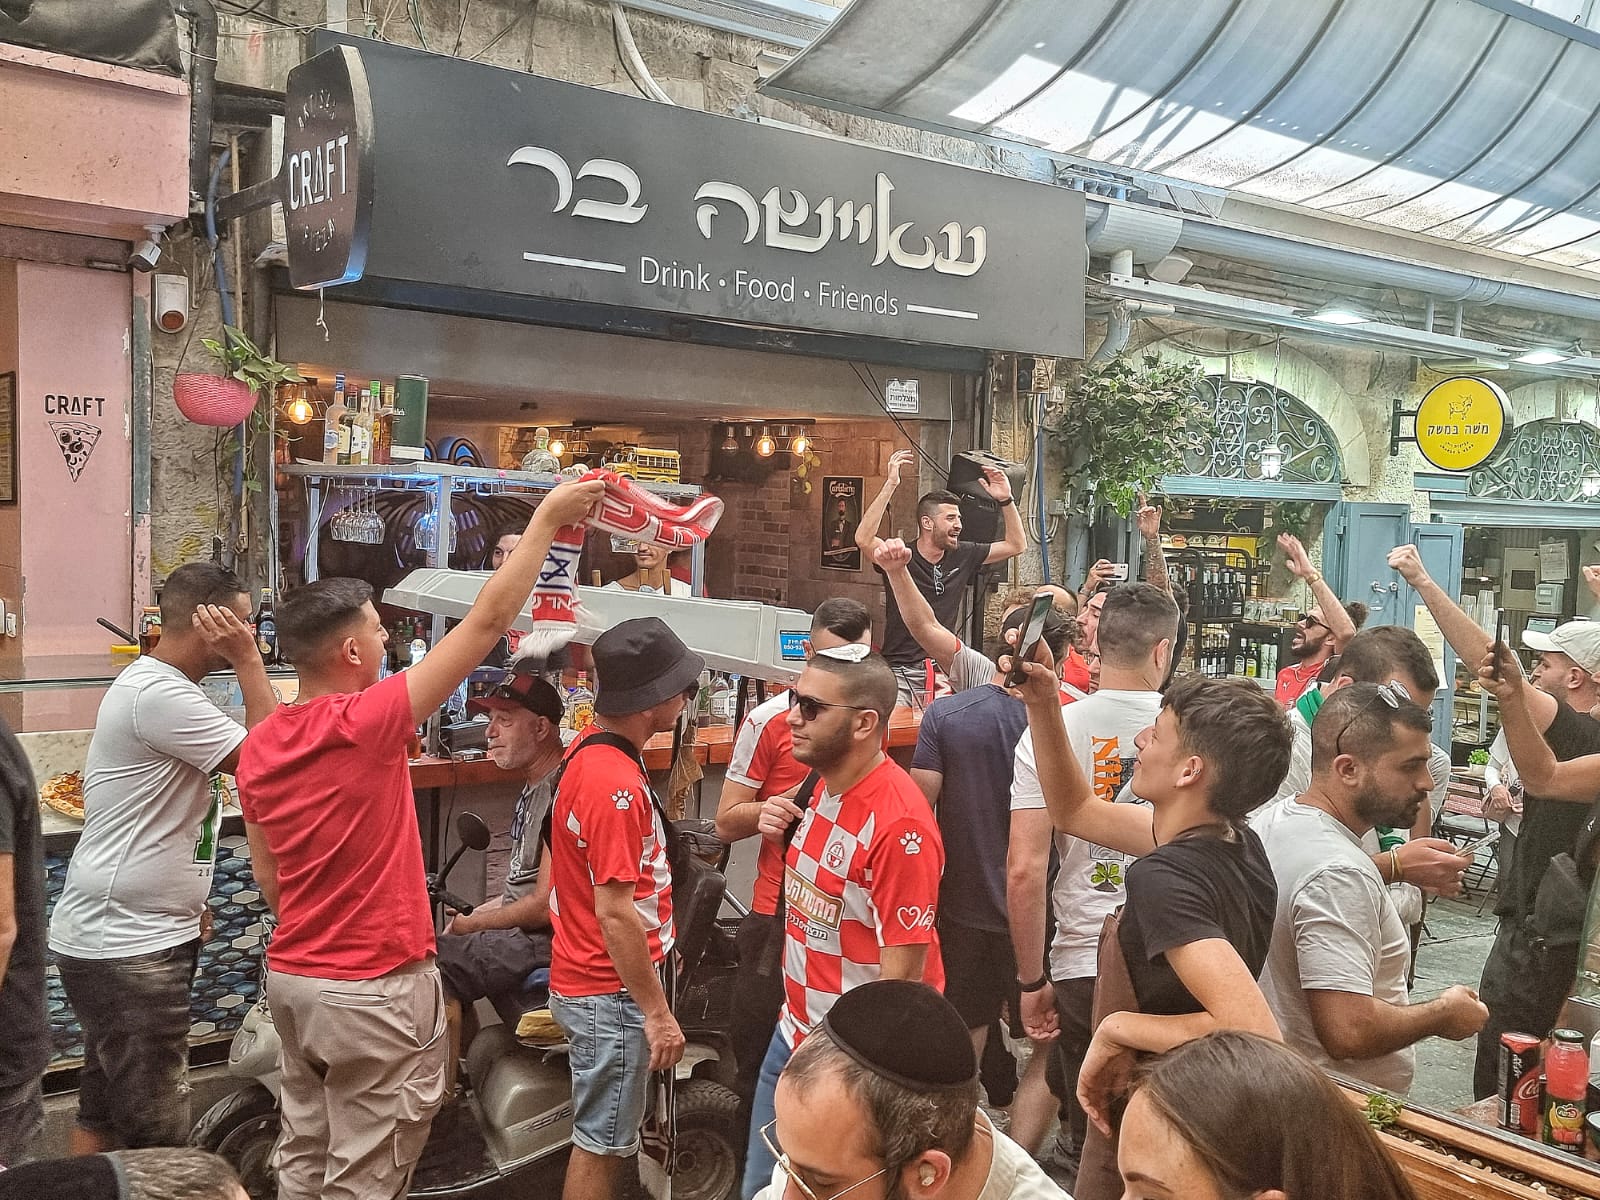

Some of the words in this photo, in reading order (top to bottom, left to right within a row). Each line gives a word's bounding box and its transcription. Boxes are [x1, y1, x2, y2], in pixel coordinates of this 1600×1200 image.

[289, 134, 349, 211] CRAFT
[507, 146, 649, 224] בר
[640, 256, 711, 292] Drink
[735, 270, 796, 303] Food
[818, 281, 899, 316] Friends
[45, 395, 105, 416] CRAFT
[1427, 425, 1459, 437] במשק
[1464, 423, 1489, 435] משה
[1092, 736, 1122, 803] Nik
